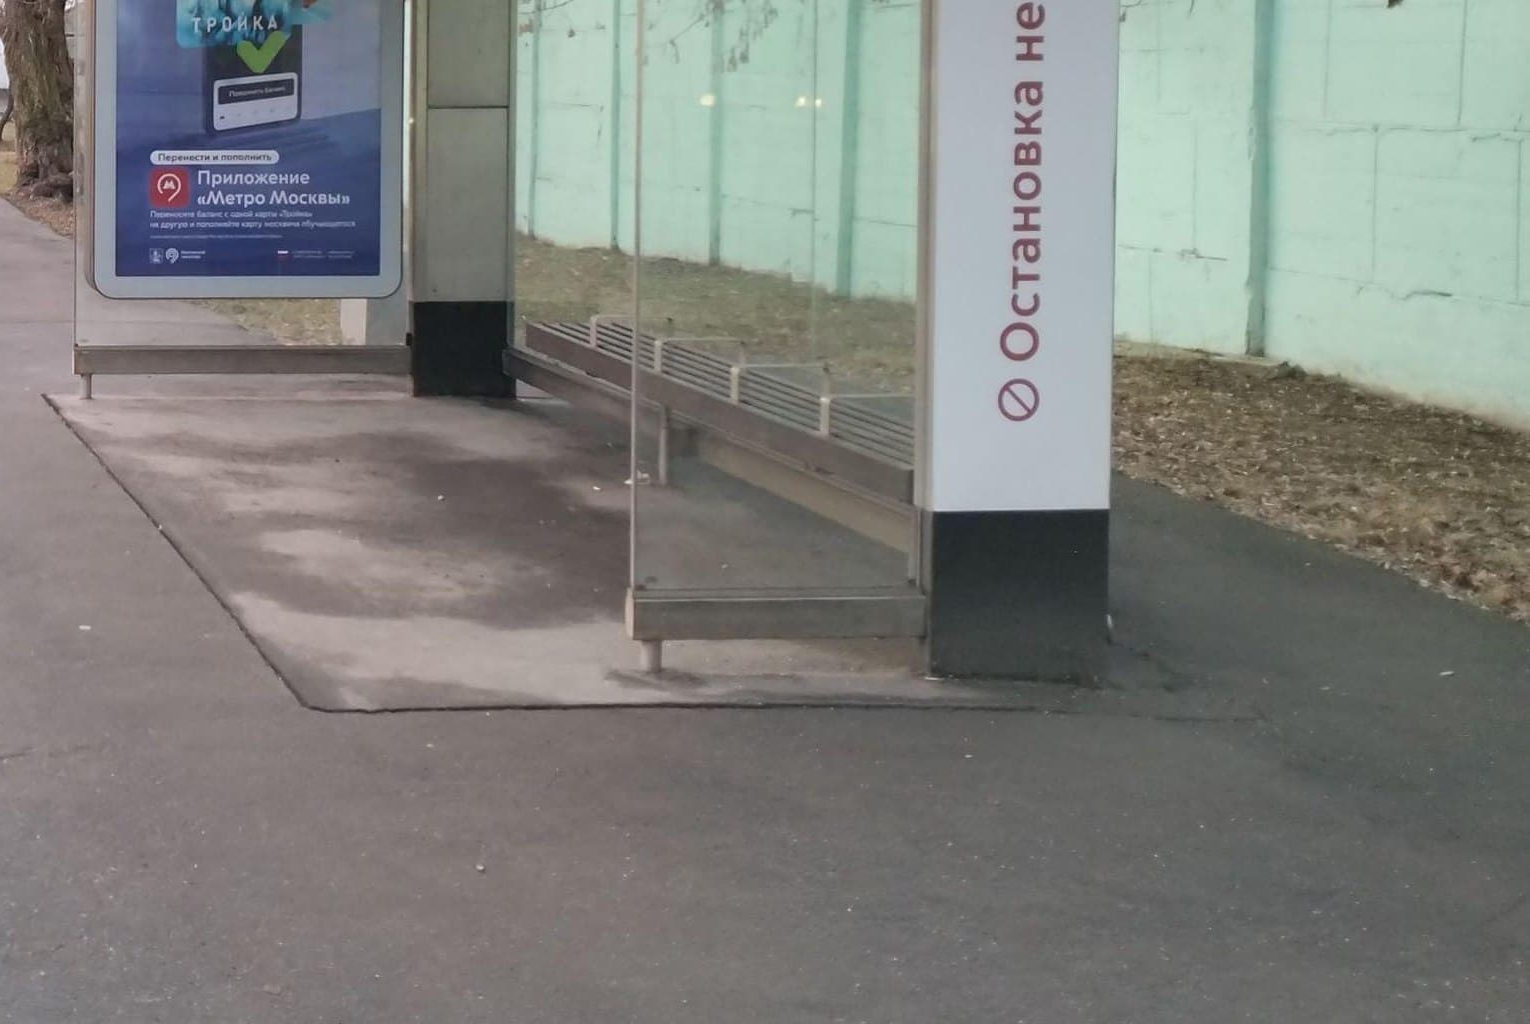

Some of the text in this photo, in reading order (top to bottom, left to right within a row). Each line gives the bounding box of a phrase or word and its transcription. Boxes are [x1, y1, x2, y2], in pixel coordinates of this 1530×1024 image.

[191, 11, 278, 33] ТРОЙКА
[1016, 2, 1045, 61] не
[158, 153, 210, 163] Перенести
[221, 154, 272, 162] пополнить
[197, 170, 310, 187] Приложение
[197, 190, 350, 207] «Метро Москвы»
[1000, 81, 1044, 362] Остановка
